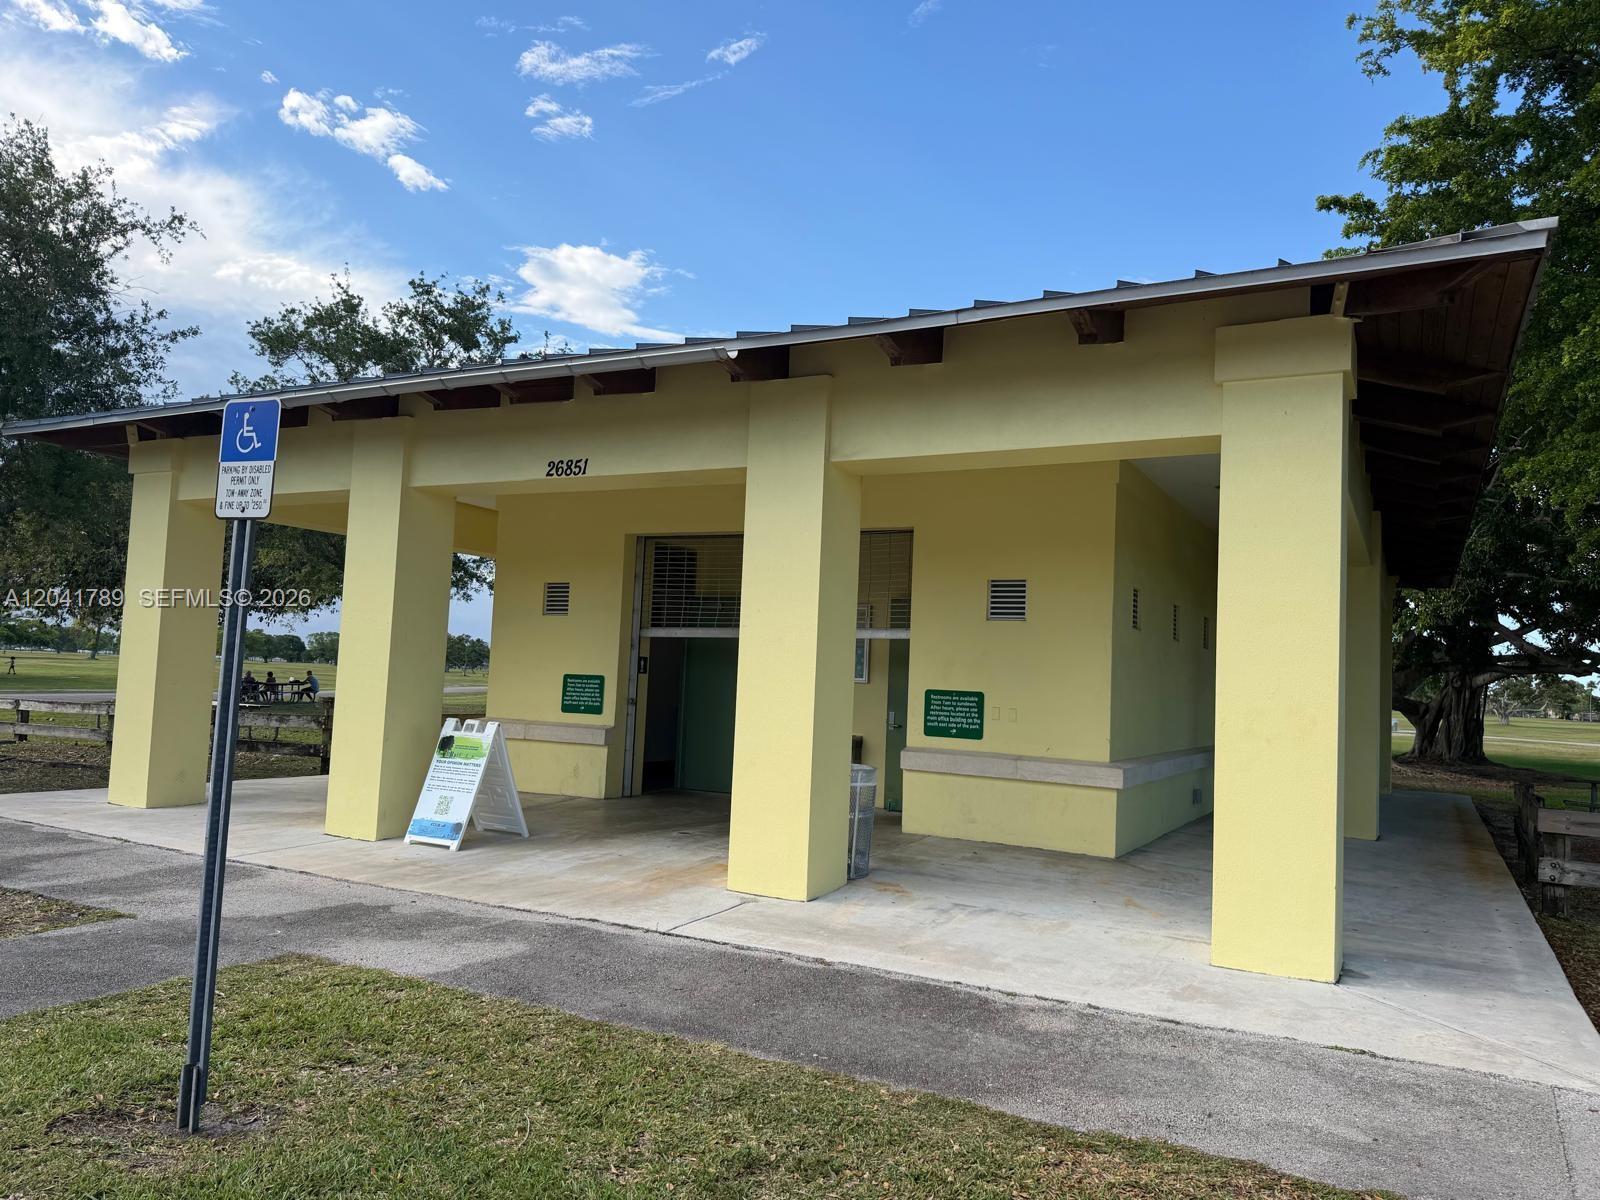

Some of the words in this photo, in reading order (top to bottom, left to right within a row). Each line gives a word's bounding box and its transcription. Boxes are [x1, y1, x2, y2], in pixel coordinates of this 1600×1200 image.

[222, 466, 240, 474] PARKING
[242, 466, 248, 474] BY
[249, 464, 271, 474] DISABLED
[546, 458, 588, 477] 26851
[231, 476, 247, 485] PERMIT
[248, 476, 260, 485] ONLY
[250, 489, 263, 497] ZONE
[225, 501, 235, 510] FINE
[236, 501, 243, 510] UP
